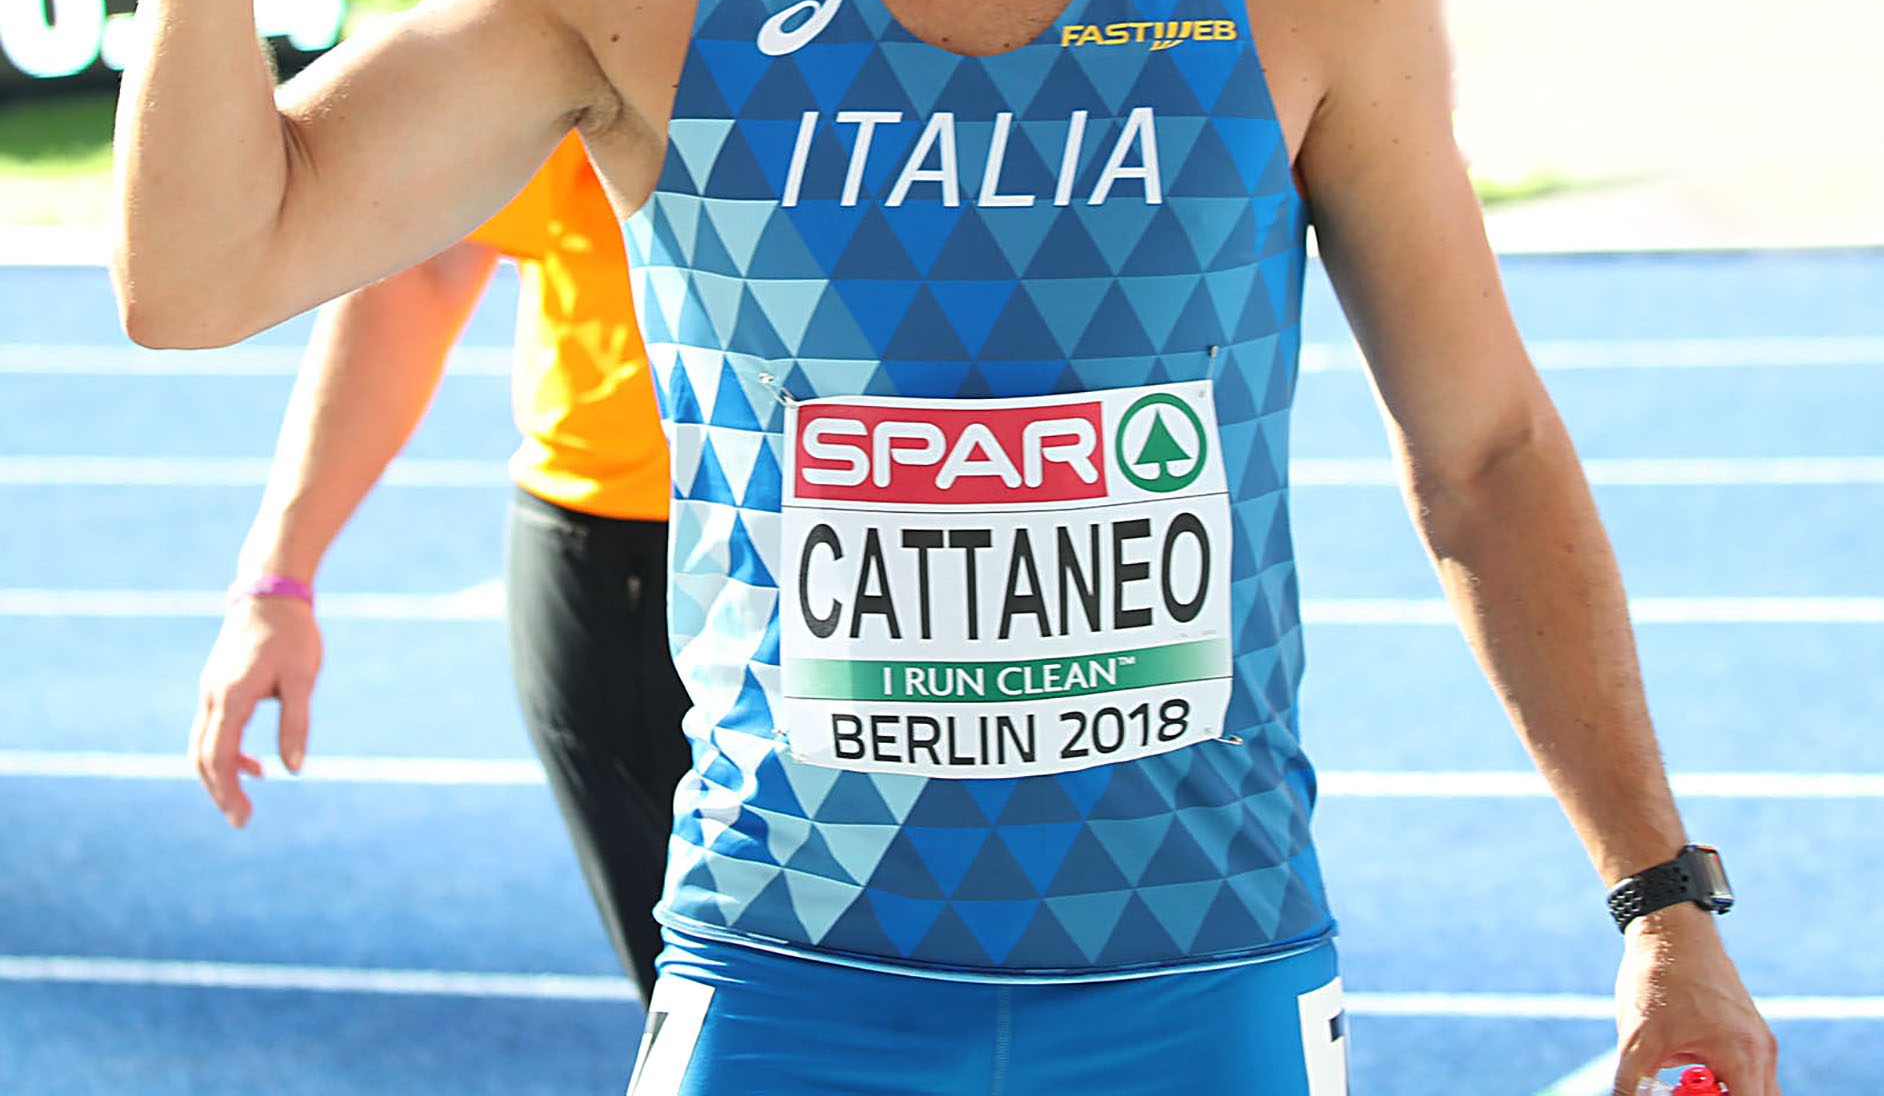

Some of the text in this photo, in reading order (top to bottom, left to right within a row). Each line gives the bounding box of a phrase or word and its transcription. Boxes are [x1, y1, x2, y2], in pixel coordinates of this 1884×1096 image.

[1060, 19, 1238, 51] FASTWEB
[781, 107, 1163, 208] ITALIA
[801, 416, 1100, 490] SPAR
[798, 511, 1212, 641] CATTANEO
[883, 666, 893, 695] I
[905, 667, 985, 696] RUN
[831, 698, 1191, 766] BERLIN 2018
